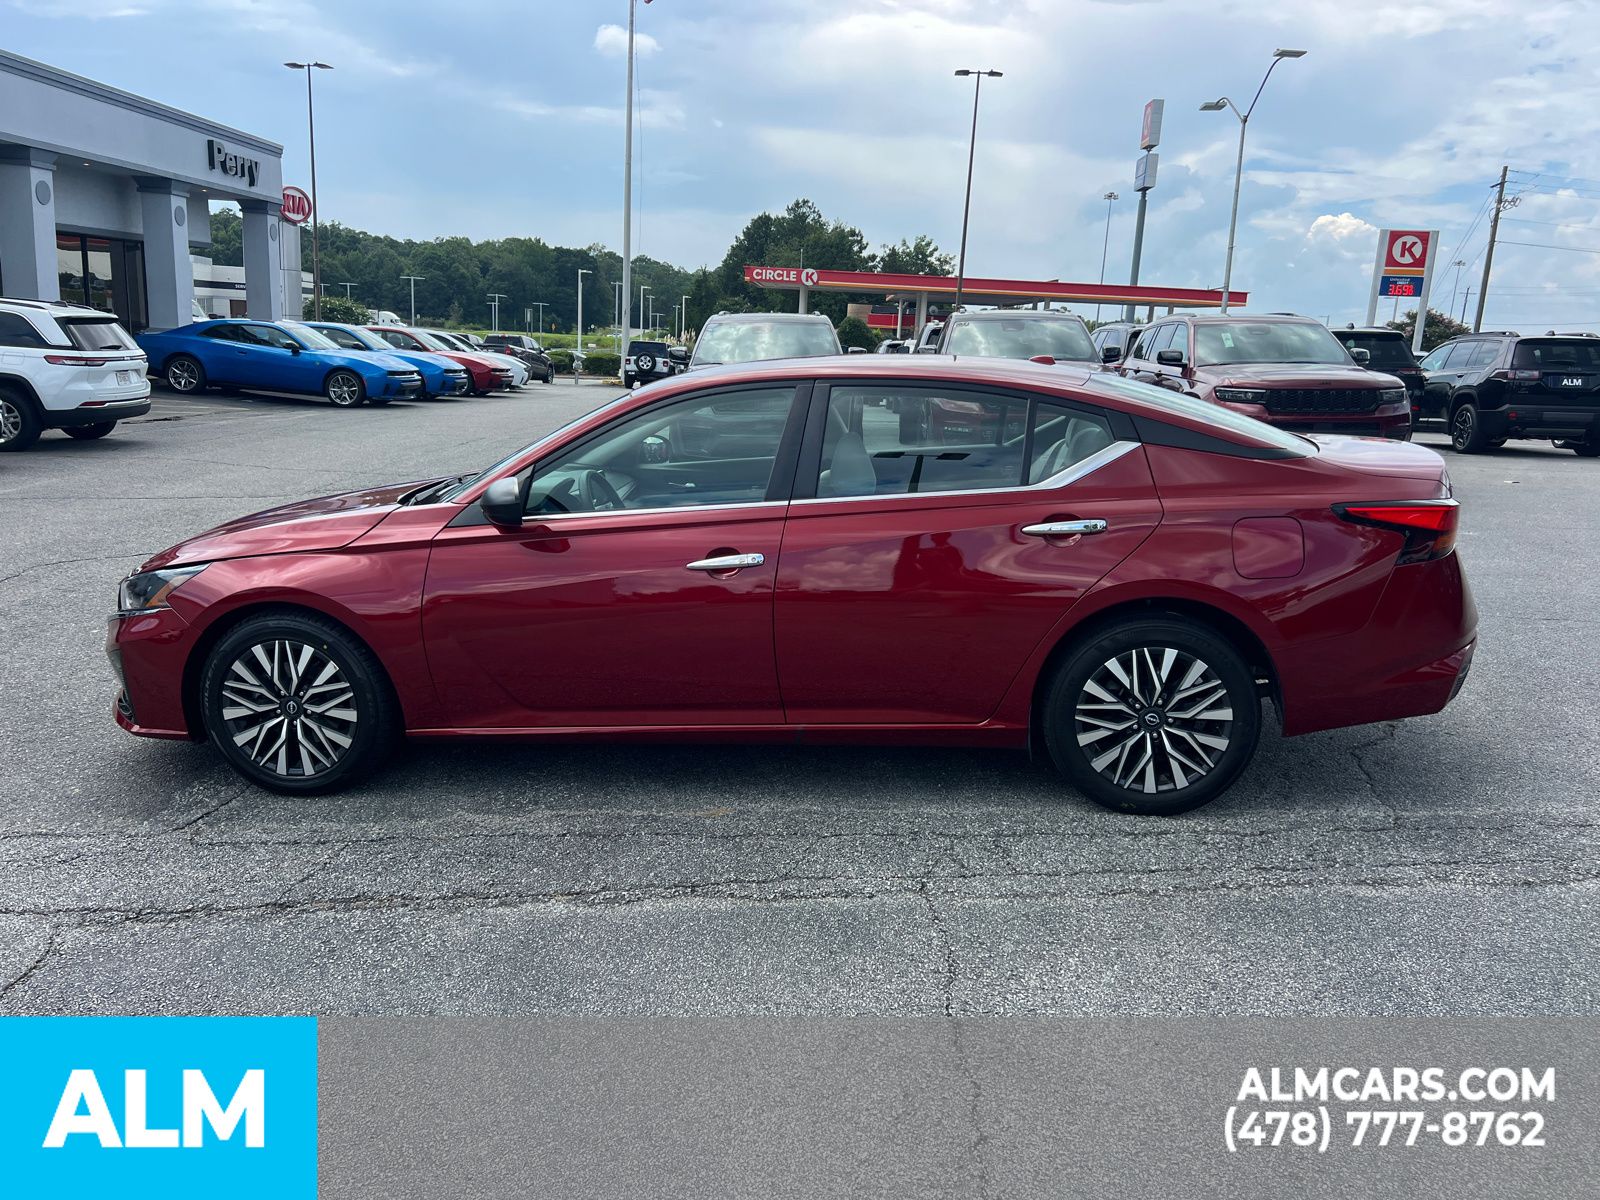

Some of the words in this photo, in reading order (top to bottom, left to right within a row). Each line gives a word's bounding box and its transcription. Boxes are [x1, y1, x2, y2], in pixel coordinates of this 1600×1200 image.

[207, 139, 259, 187] Perry
[283, 192, 306, 216] KIA
[1400, 241, 1418, 262] K
[752, 268, 797, 281] CIRCLE
[804, 270, 818, 286] K
